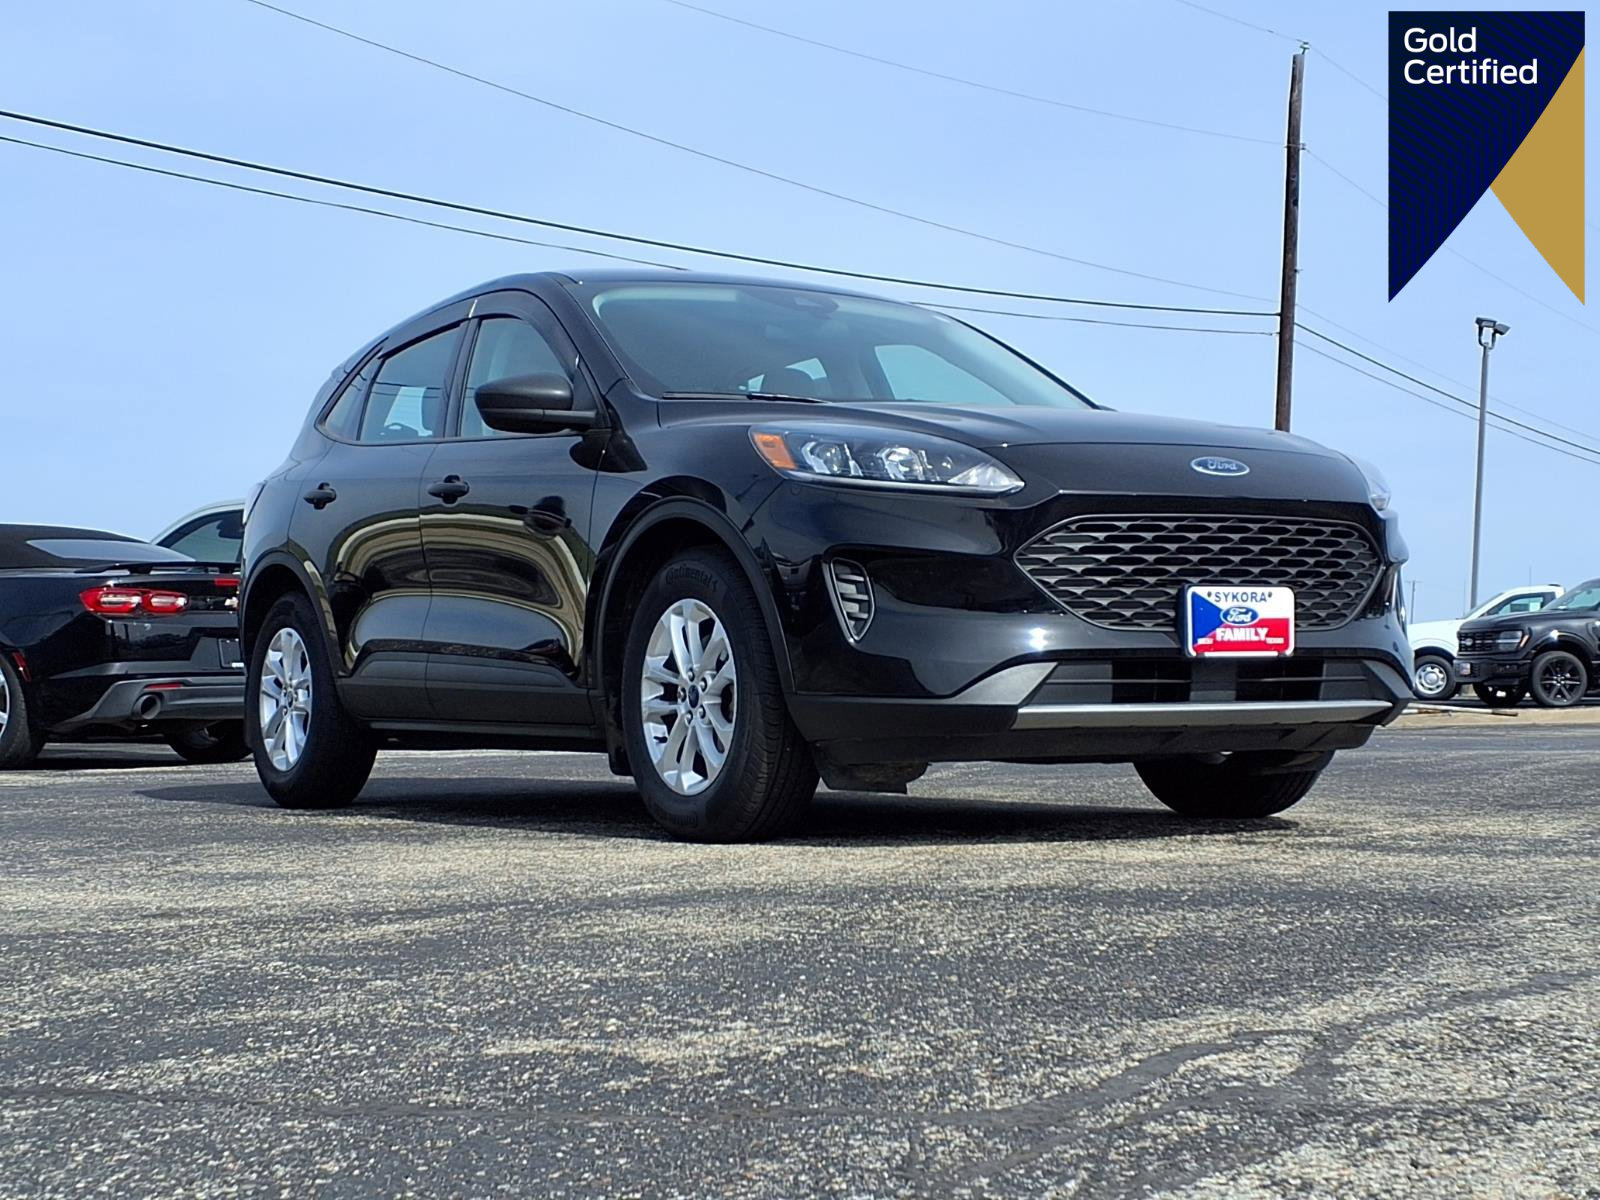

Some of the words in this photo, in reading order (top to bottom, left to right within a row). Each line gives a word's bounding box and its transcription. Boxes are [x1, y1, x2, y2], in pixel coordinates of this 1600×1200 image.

[1214, 591, 1268, 603] SYKORA
[1226, 607, 1253, 622] Ford
[1215, 627, 1270, 642] FAMILY
